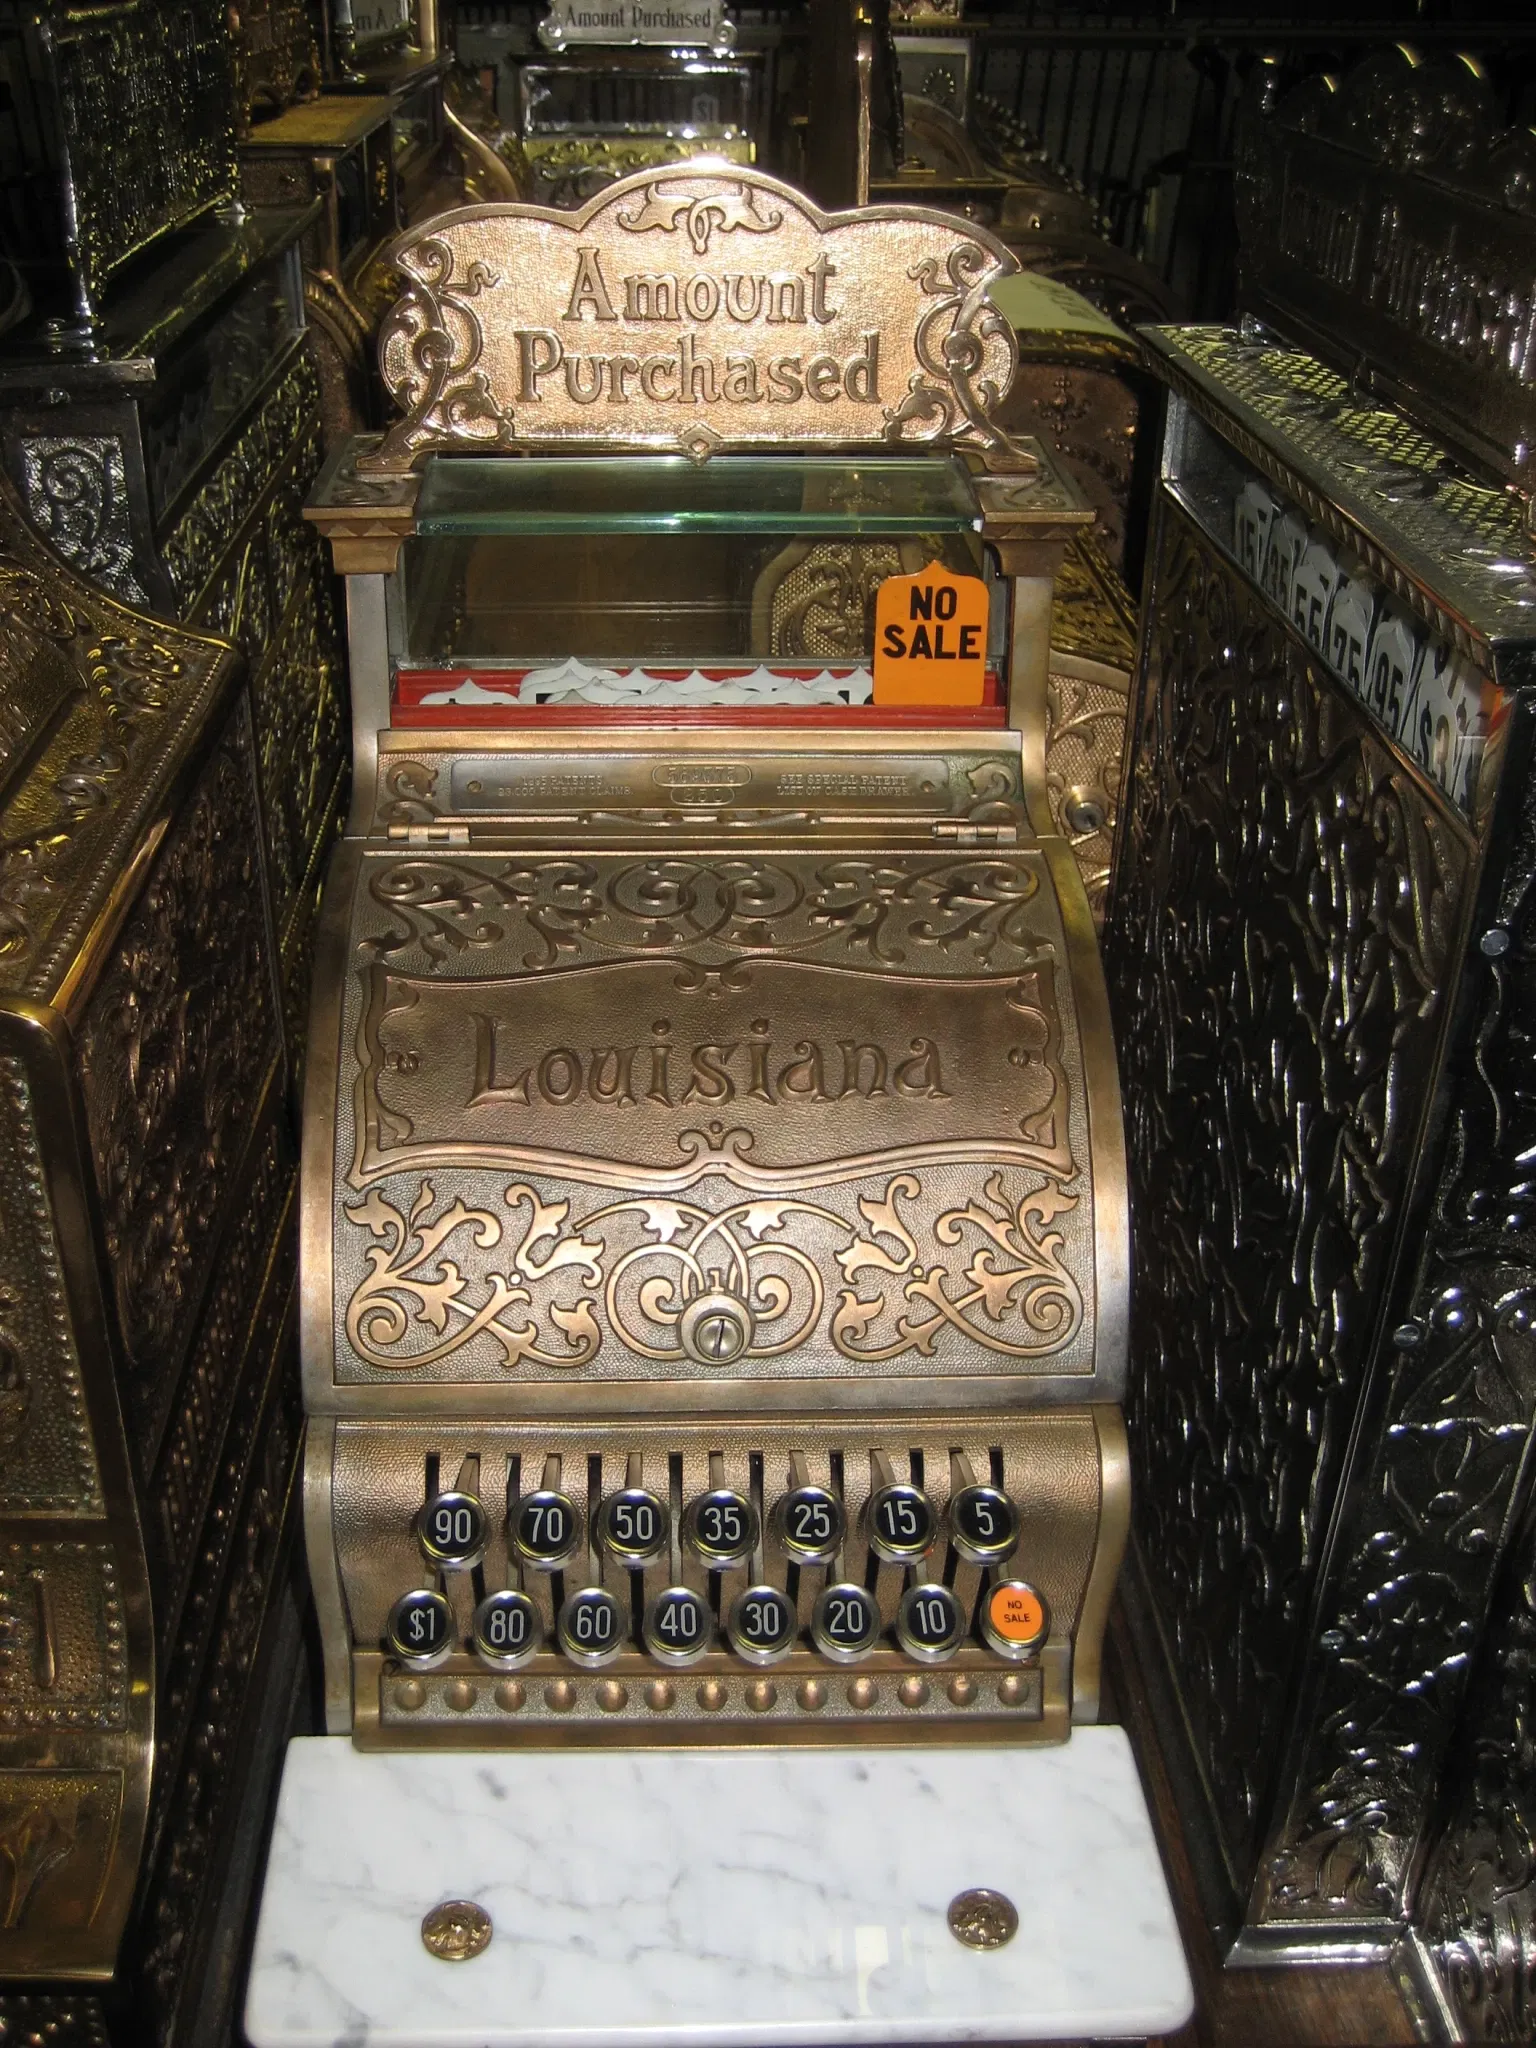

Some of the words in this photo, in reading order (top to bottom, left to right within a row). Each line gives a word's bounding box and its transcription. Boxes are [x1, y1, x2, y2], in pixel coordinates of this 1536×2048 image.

[565, 5, 625, 28] Amount
[632, 6, 711, 28] Purchased
[562, 246, 838, 323] Amount
[513, 329, 881, 403] Purchased
[909, 585, 958, 621] NO
[882, 624, 982, 660] SALE
[1334, 623, 1362, 697] 75
[1375, 651, 1404, 738] 95
[780, 773, 803, 785] SEE
[807, 773, 859, 785] SPECIAL
[861, 775, 907, 786] PATENT
[464, 1011, 955, 1108] Louisiana
[435, 1508, 472, 1544] 90
[528, 1507, 563, 1543] 70
[616, 1505, 653, 1540] 50
[704, 1507, 741, 1541] 35
[794, 1504, 830, 1538] 25
[883, 1500, 917, 1536] 15
[975, 1502, 994, 1536] 5
[576, 1605, 611, 1639] 60
[660, 1603, 697, 1637] 40
[746, 1602, 779, 1636] 30
[828, 1600, 863, 1634] 20
[916, 1600, 946, 1634] 10
[1003, 1613, 1031, 1623] SALE
[1007, 1601, 1023, 1609] NO
[409, 1607, 435, 1641] $1
[490, 1609, 525, 1643] 80
